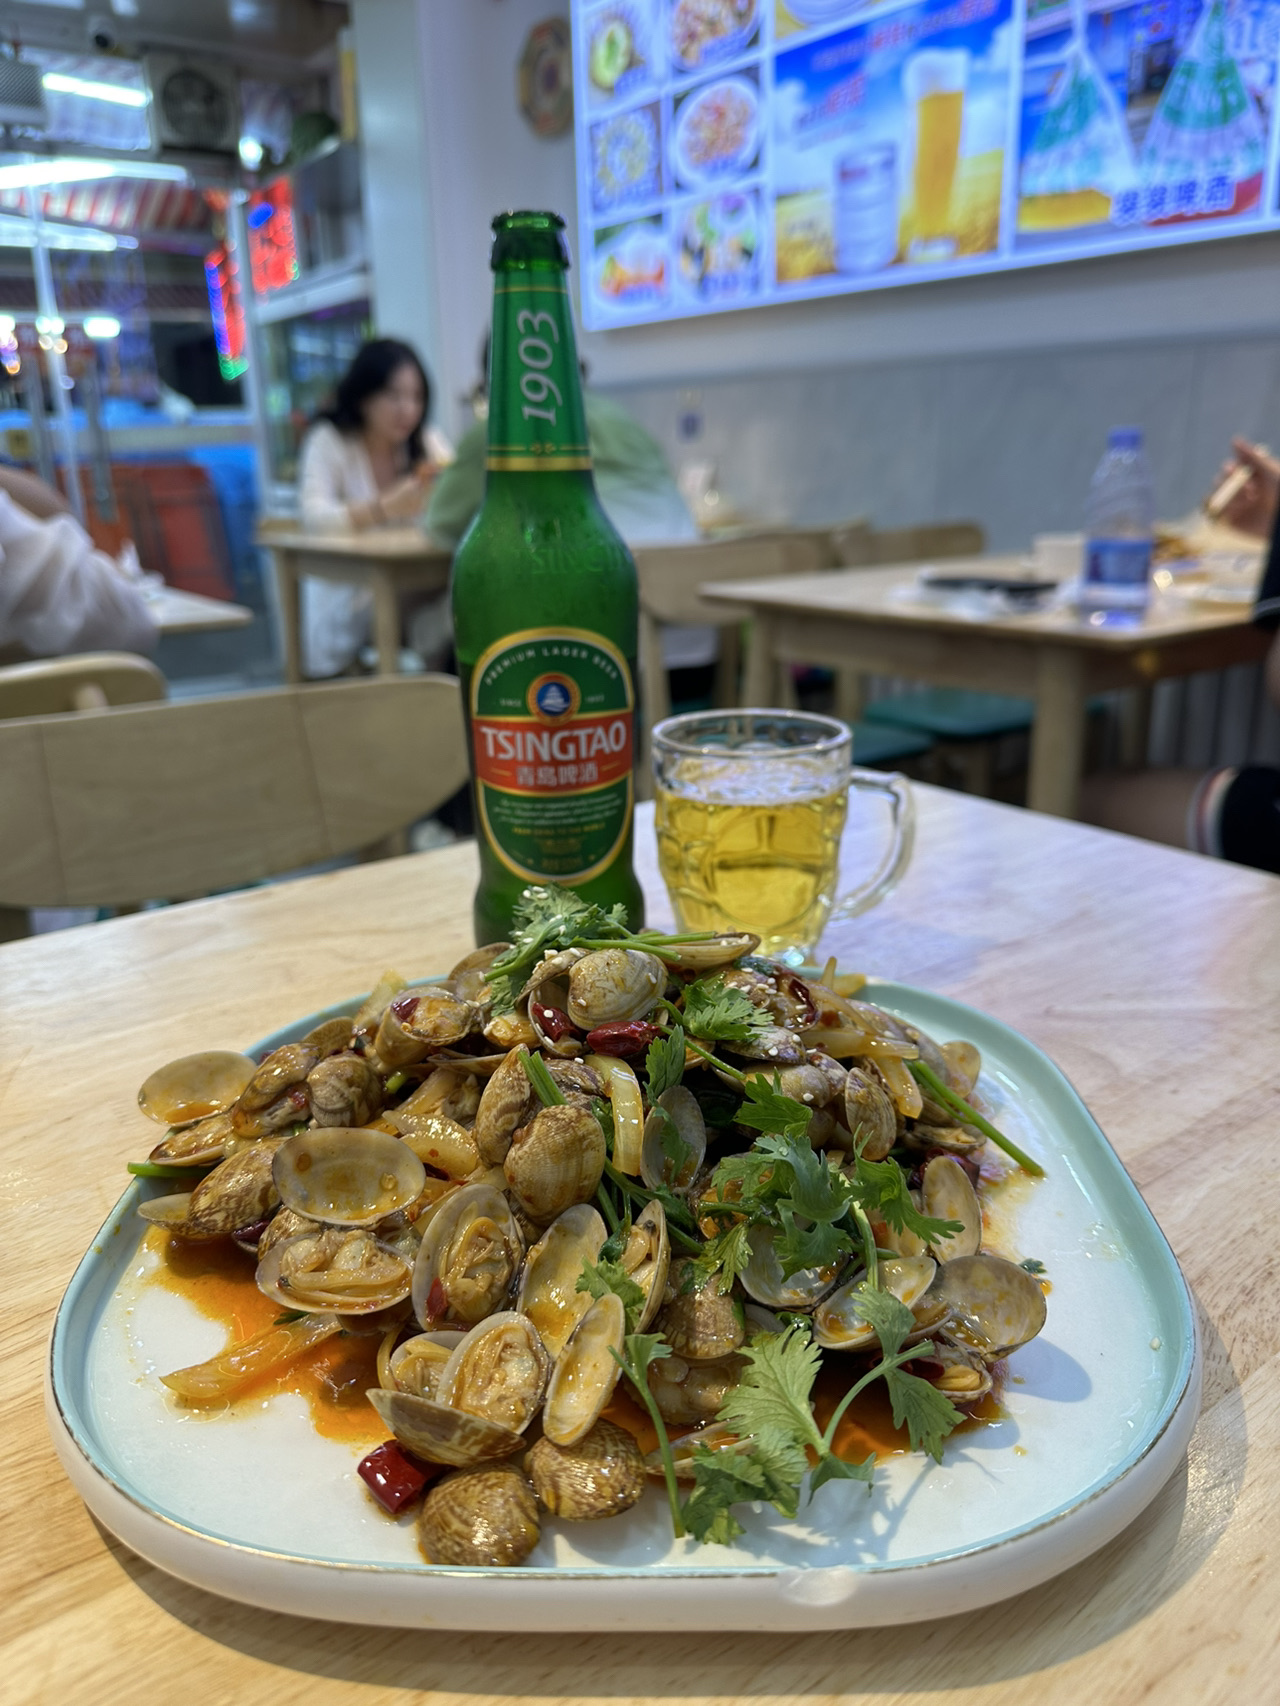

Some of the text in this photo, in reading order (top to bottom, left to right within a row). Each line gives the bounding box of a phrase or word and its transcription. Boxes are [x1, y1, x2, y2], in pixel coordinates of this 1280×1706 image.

[517, 309, 563, 427] 1903
[484, 648, 536, 686] PREMIUM
[541, 646, 588, 659] LAGER
[480, 720, 627, 762] TSINGTAO
